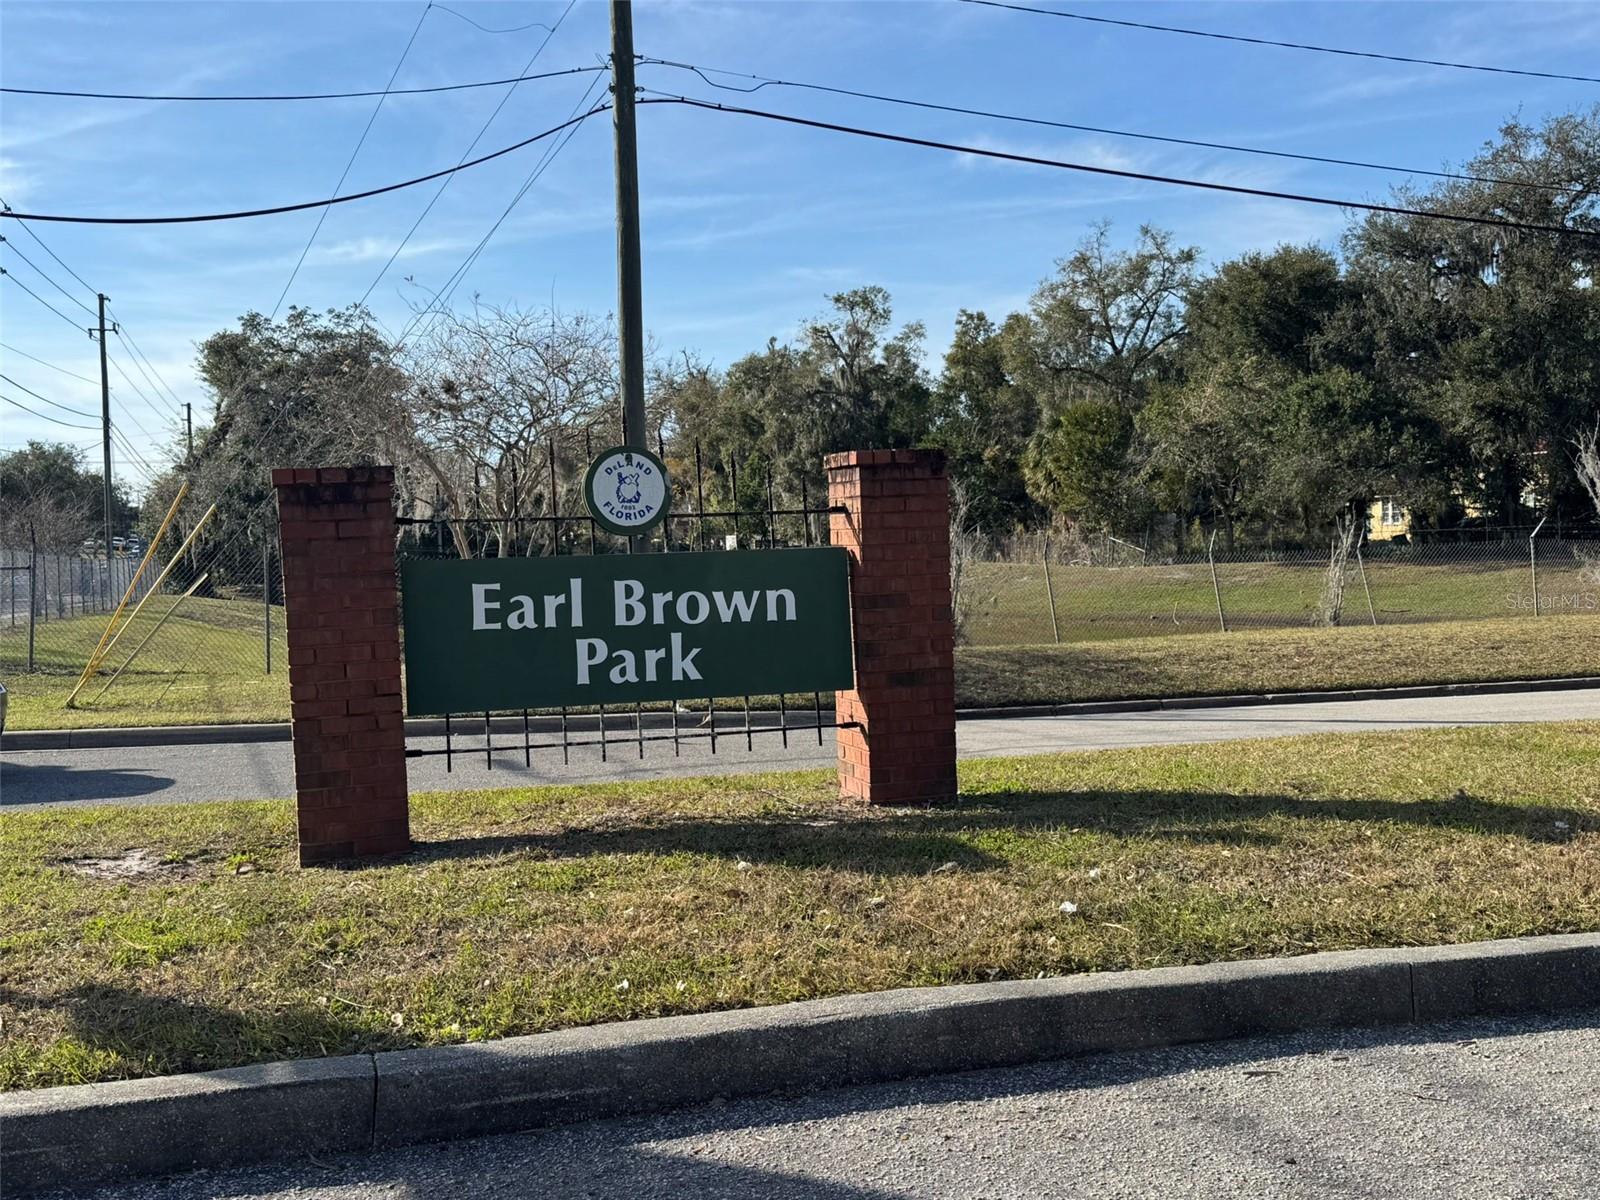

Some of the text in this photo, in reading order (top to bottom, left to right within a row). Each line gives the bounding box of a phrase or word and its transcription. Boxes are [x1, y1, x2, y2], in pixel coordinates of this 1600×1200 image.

[604, 501, 653, 520] FLORIDA
[472, 578, 797, 631] Earl Brown
[576, 632, 703, 685] Park
